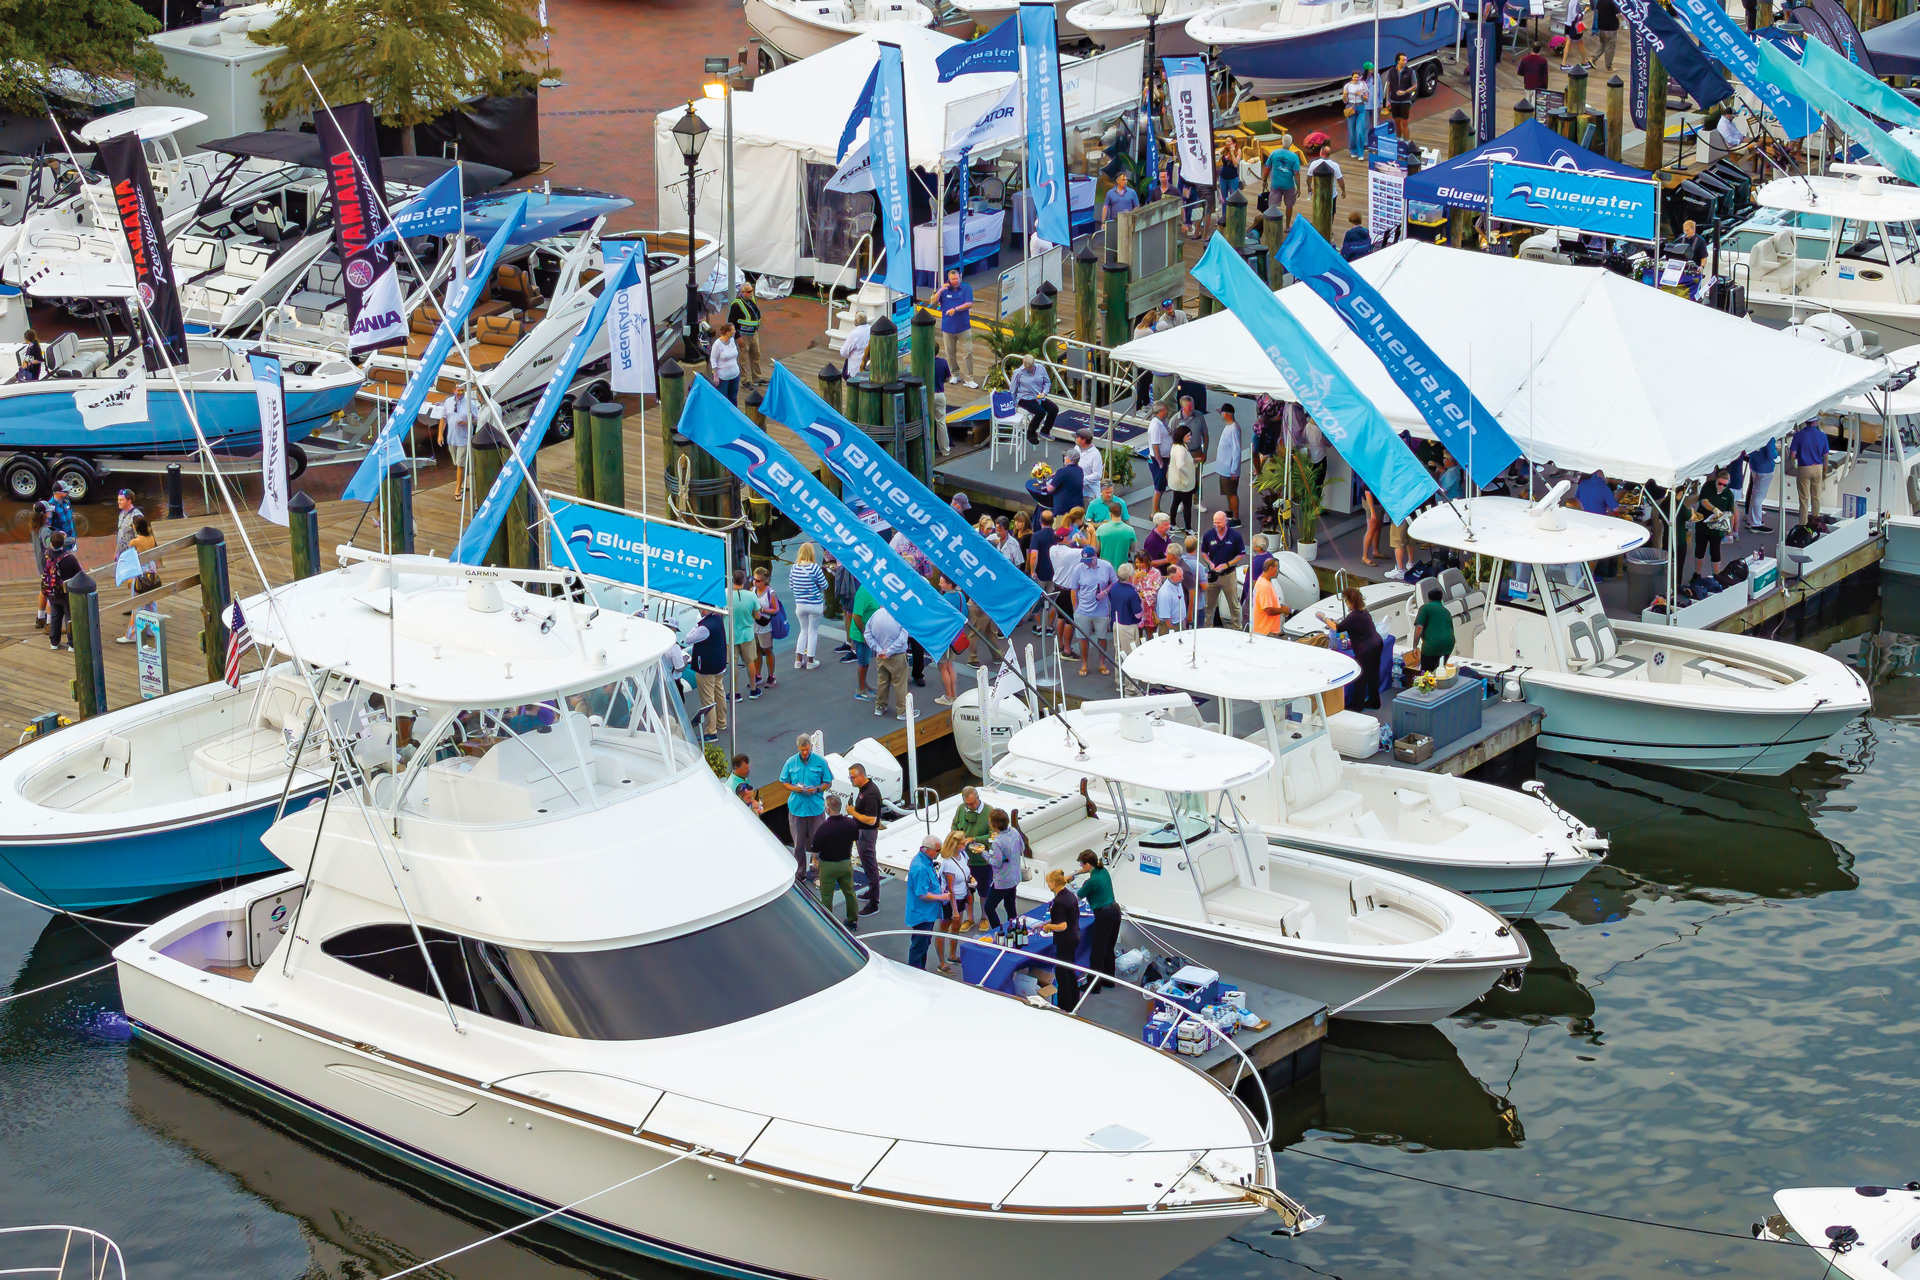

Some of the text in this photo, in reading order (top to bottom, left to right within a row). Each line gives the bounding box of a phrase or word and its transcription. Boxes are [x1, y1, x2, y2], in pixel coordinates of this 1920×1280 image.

[115, 178, 149, 281] YAMAHA
[331, 150, 367, 259] YAMAHA
[1535, 187, 1643, 211] Bluewater
[1554, 203, 1634, 219] YACHT SALES
[1350, 295, 1477, 436] Bluewater
[1366, 333, 1453, 438] YACHT SALES
[596, 531, 712, 569] Bluewater
[767, 461, 924, 606] Bluewater
[791, 502, 899, 612] YACHT SALES
[843, 443, 997, 583] Bluewater
[863, 486, 974, 588] YACHT SALES
[465, 569, 499, 577] GARMIN
[617, 555, 704, 580] YACT SALES
[1142, 854, 1152, 863] NO
